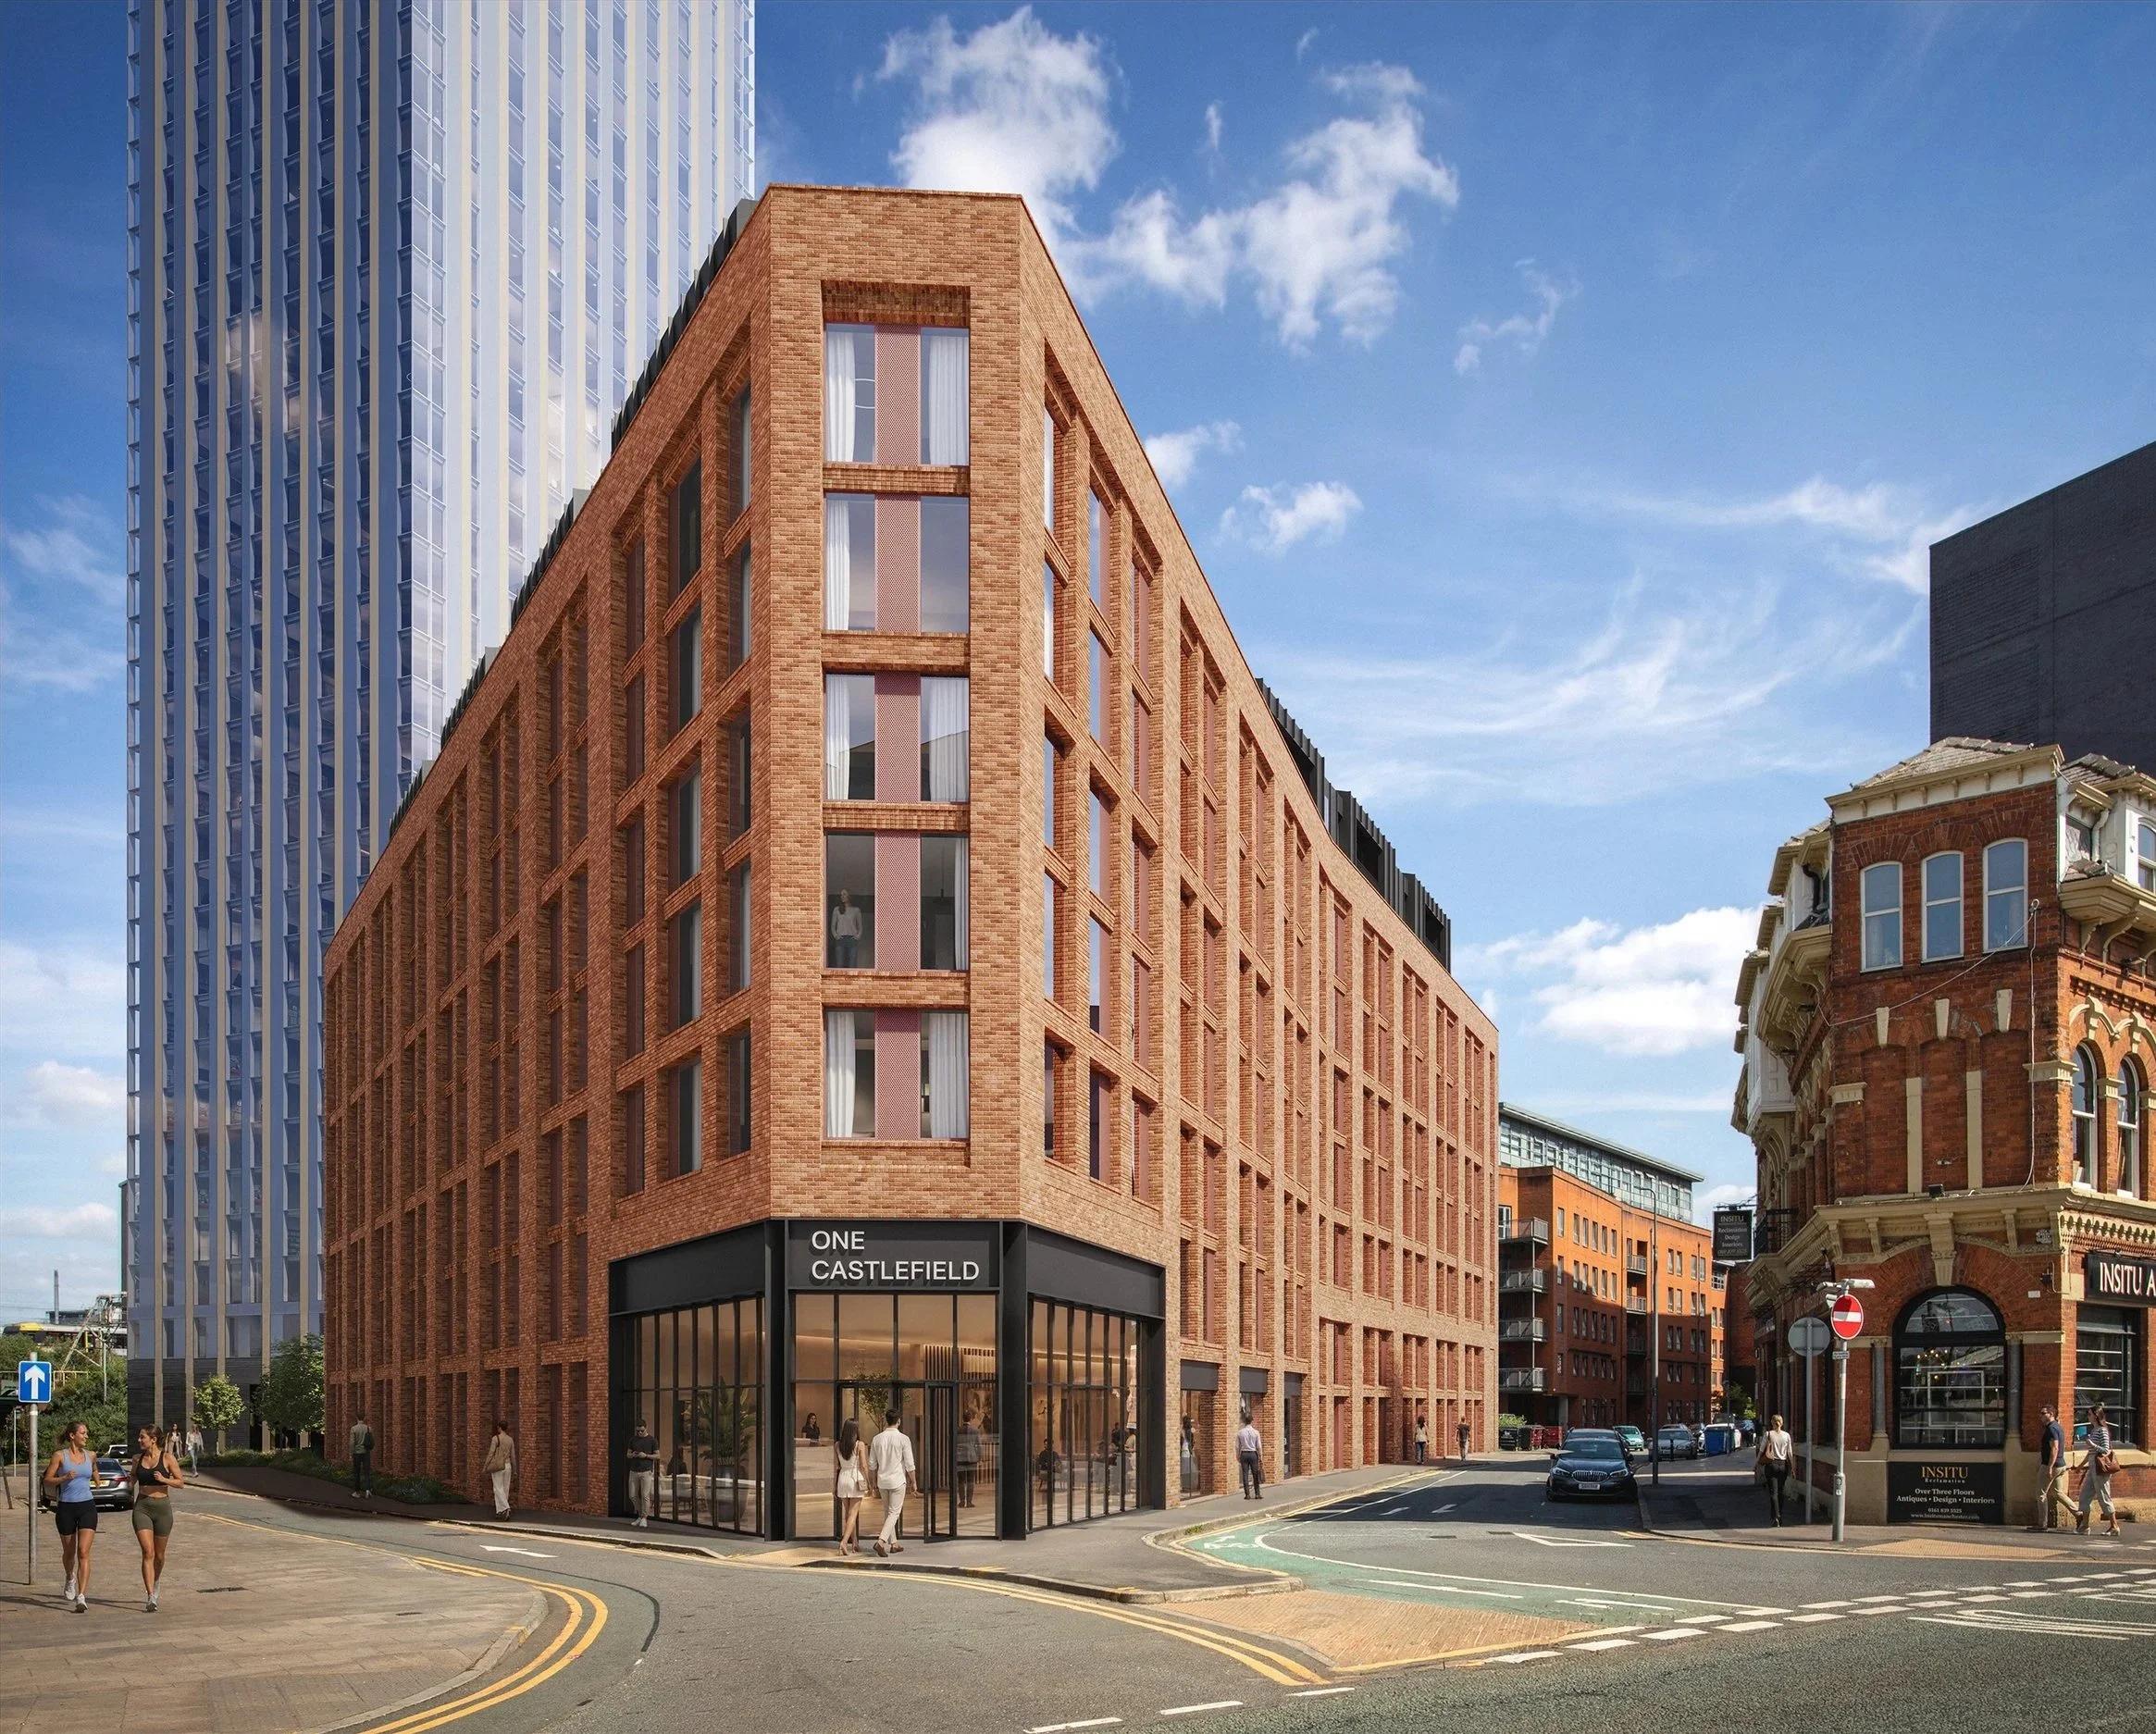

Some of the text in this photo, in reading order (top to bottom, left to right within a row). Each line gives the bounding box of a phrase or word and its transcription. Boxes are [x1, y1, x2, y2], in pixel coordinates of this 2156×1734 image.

[812, 1231, 865, 1250] ONE
[812, 1260, 980, 1281] CASTLEFIELD
[2100, 1261, 2143, 1295] INSITU
[1921, 1466, 1969, 1479] INSITU
[1896, 1495, 1927, 1504] Antiques
[1933, 1496, 1957, 1505] Design
